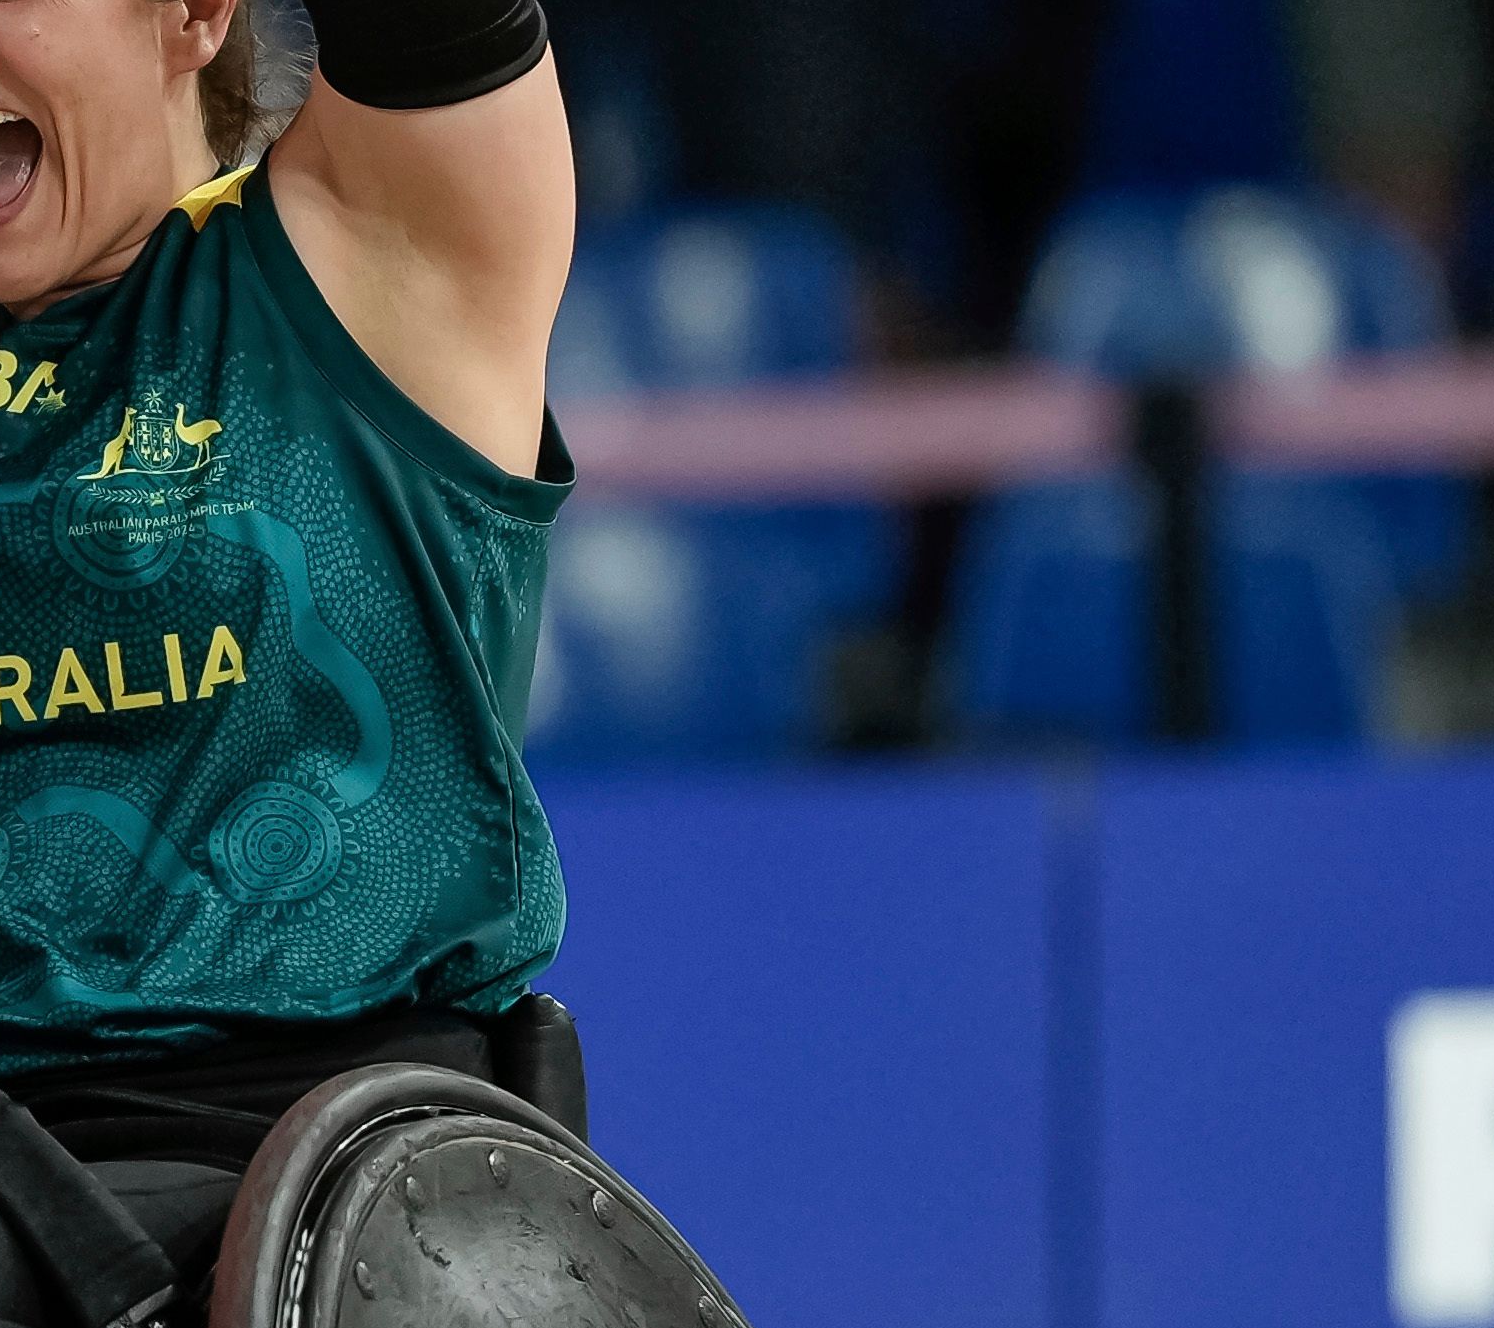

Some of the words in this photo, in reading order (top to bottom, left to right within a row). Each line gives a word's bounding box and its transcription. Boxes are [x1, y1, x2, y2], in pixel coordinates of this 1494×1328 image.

[68, 517, 143, 537] AUSTRALIAN
[145, 503, 220, 529] PARALYMPIC
[222, 499, 255, 517] TEAM
[128, 529, 164, 544] PARIS
[167, 523, 195, 540] 2024
